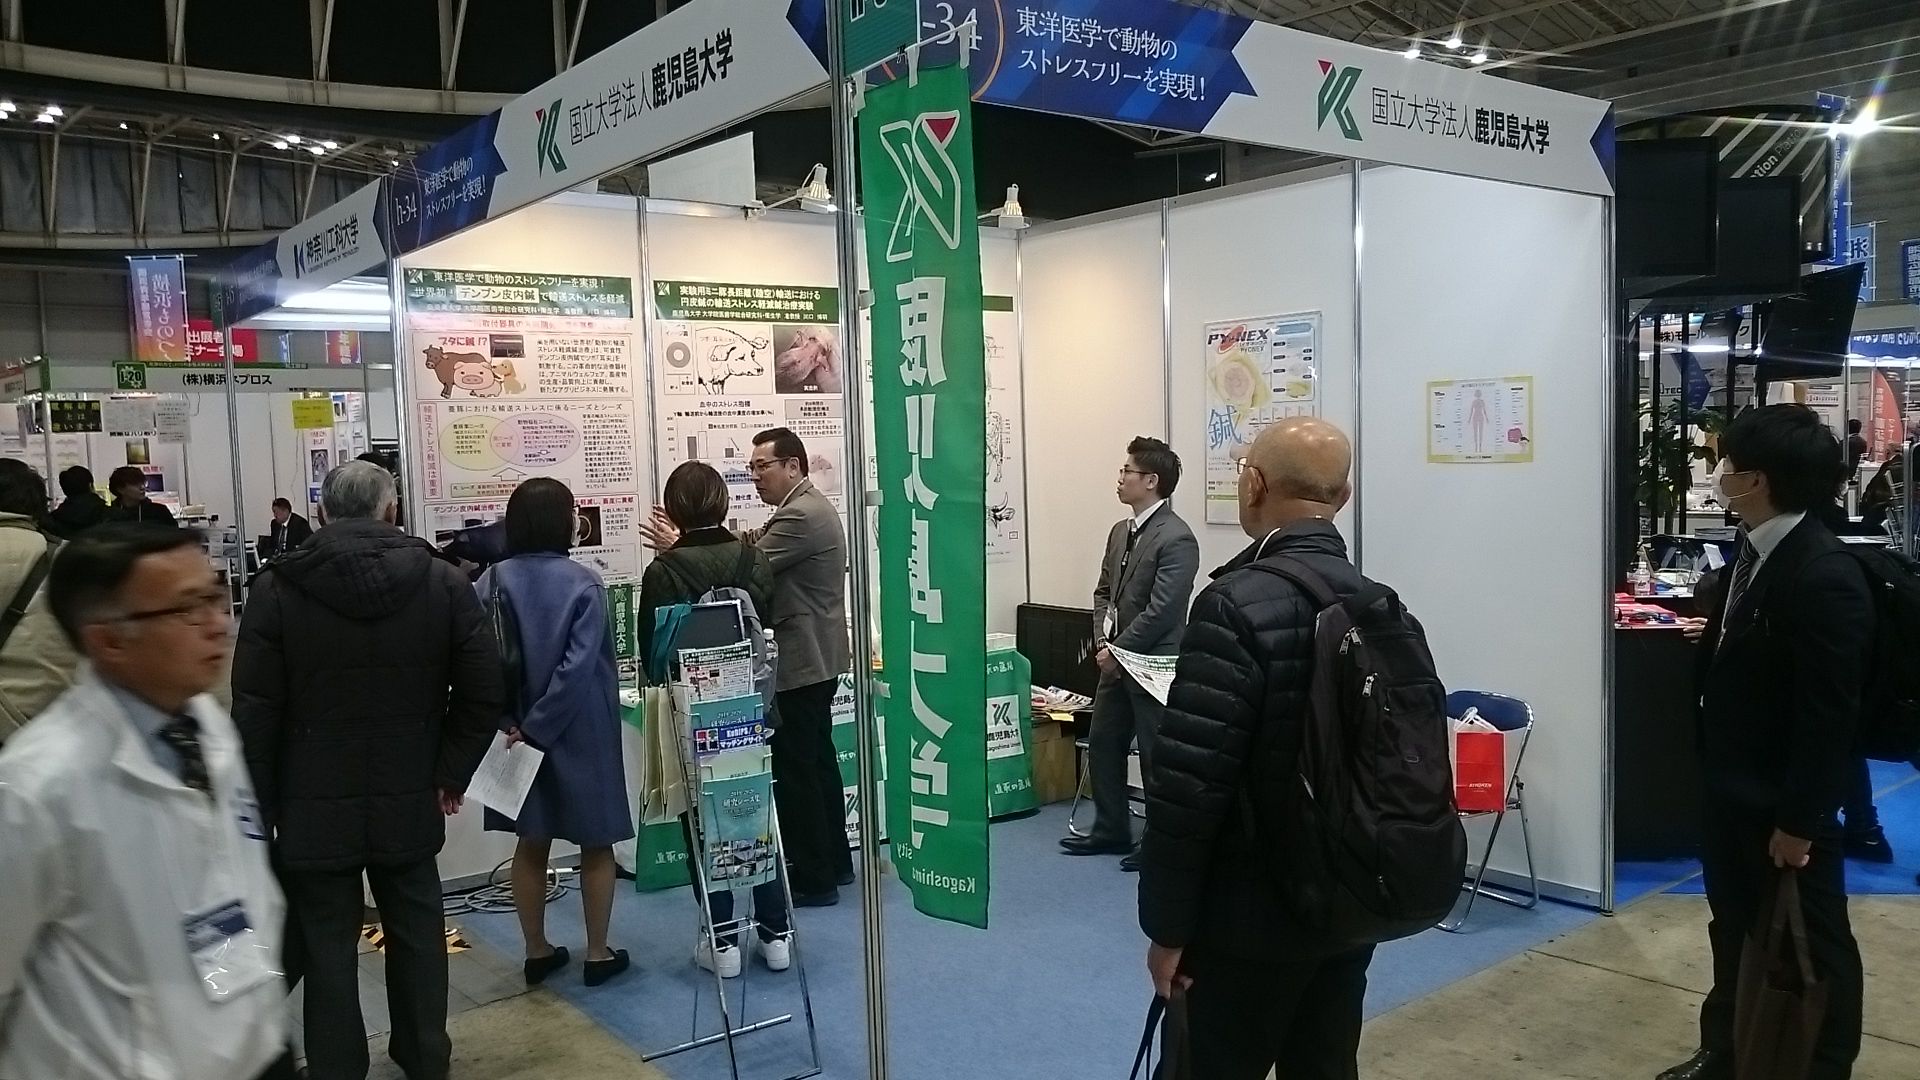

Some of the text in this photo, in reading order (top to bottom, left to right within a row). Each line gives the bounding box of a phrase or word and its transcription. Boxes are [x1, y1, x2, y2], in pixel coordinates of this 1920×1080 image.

[1015, 7, 1178, 61] 東洋医学で動物の
[569, 28, 734, 146] 国立大学法人鹿児島大学
[1372, 87, 1550, 154] 国立大学法人鹿児島大学
[424, 157, 473, 196] 東洋医学で動物の
[395, 192, 417, 226] h-34
[306, 213, 359, 264] 神奈川工科大学
